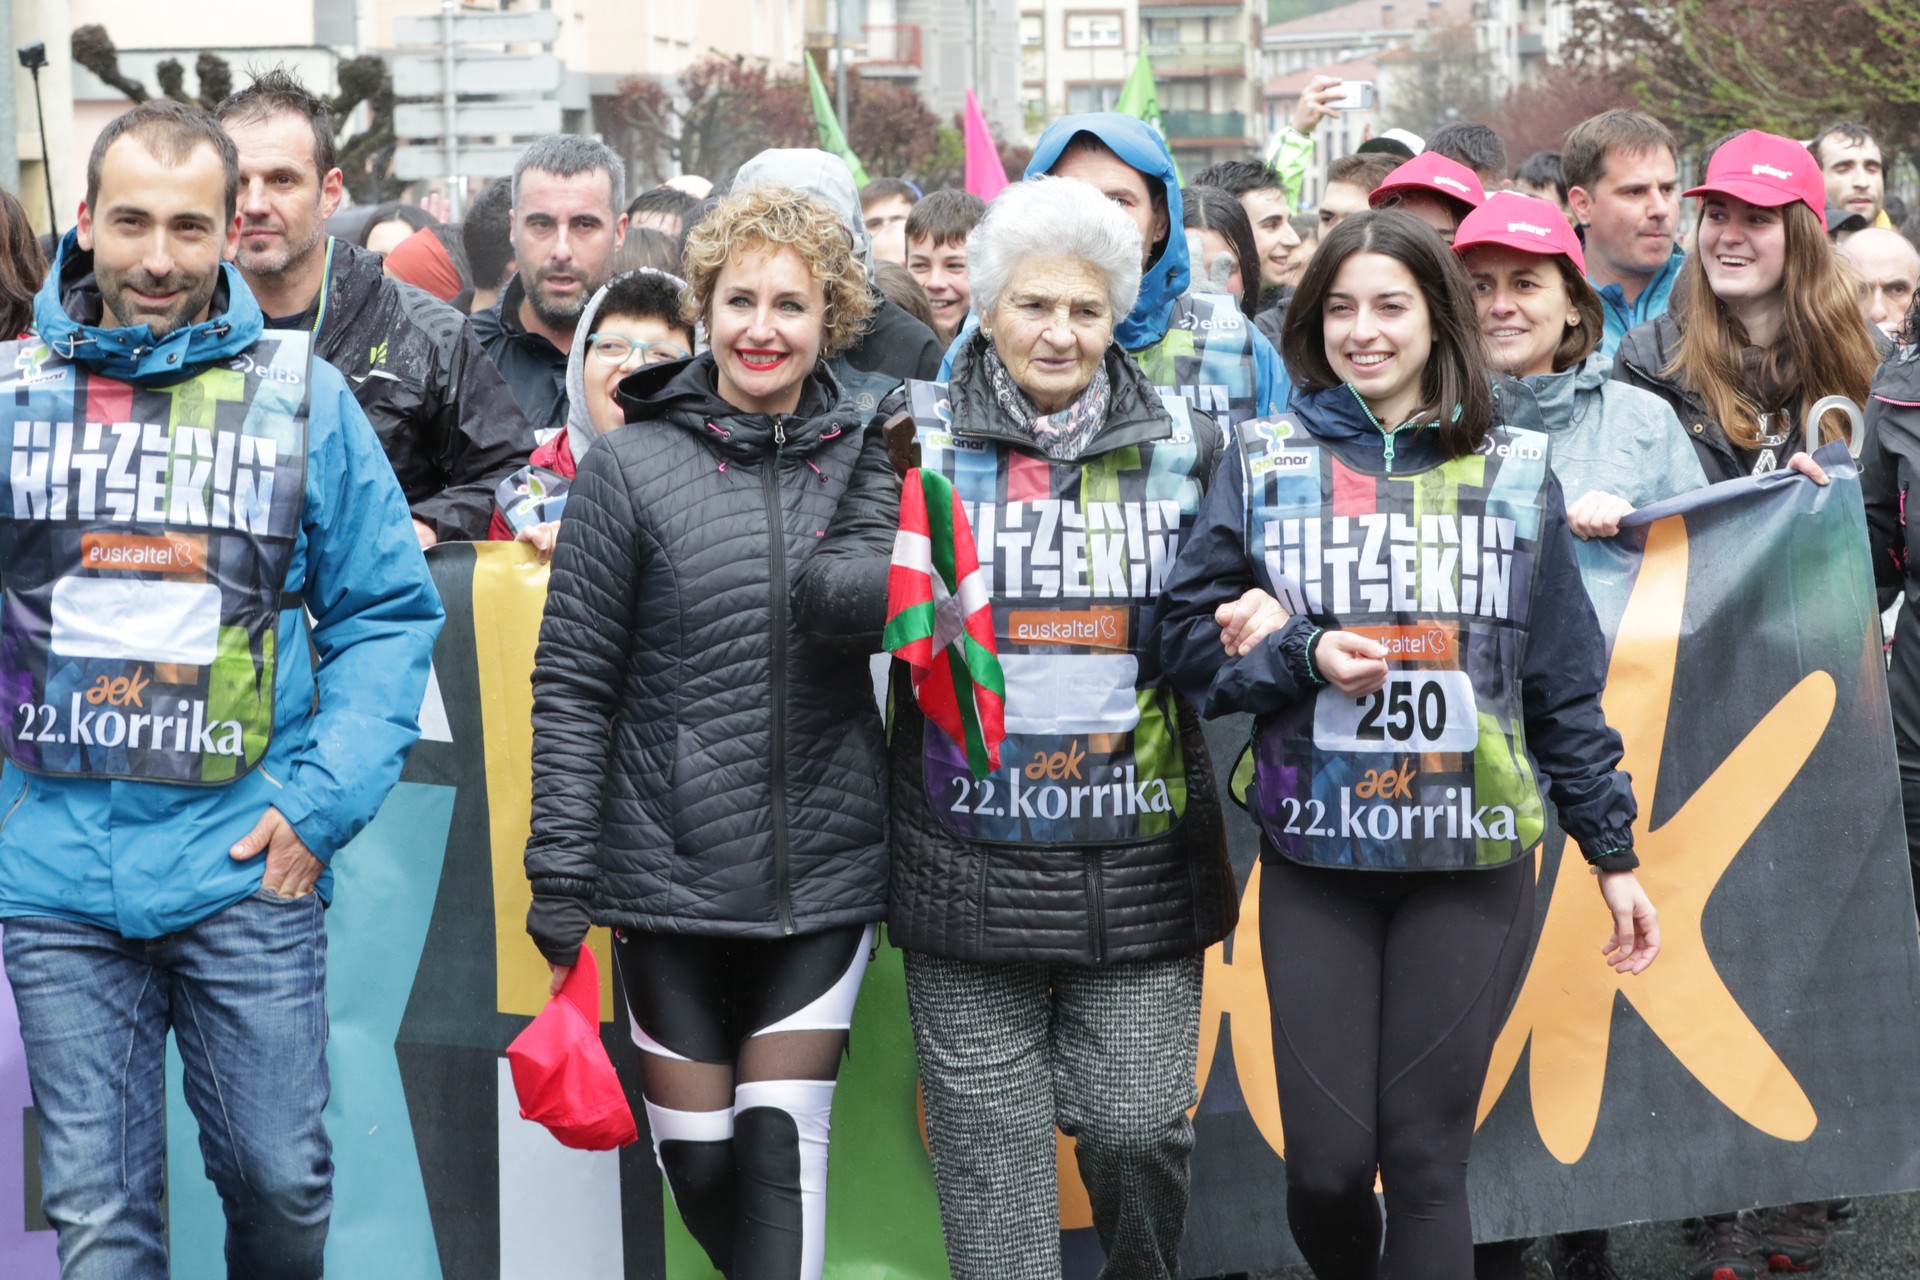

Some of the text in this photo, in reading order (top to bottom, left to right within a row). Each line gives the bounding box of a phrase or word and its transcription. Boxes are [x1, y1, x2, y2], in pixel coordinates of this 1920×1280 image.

[1200, 316, 1241, 330] eitb
[255, 363, 300, 384] eitb
[1496, 443, 1542, 460] eitb
[89, 543, 173, 566] euskaltel
[963, 499, 1181, 599] ITZEKIN
[1017, 619, 1099, 640] euskaltel
[1375, 634, 1426, 654] kaltel
[86, 665, 150, 708] aek
[70, 692, 244, 757] korrika
[1356, 680, 1446, 741] 250
[1024, 739, 1086, 781] aek
[1355, 757, 1416, 799] aek
[1010, 764, 1172, 820] korrika
[1341, 786, 1518, 841] korrika
